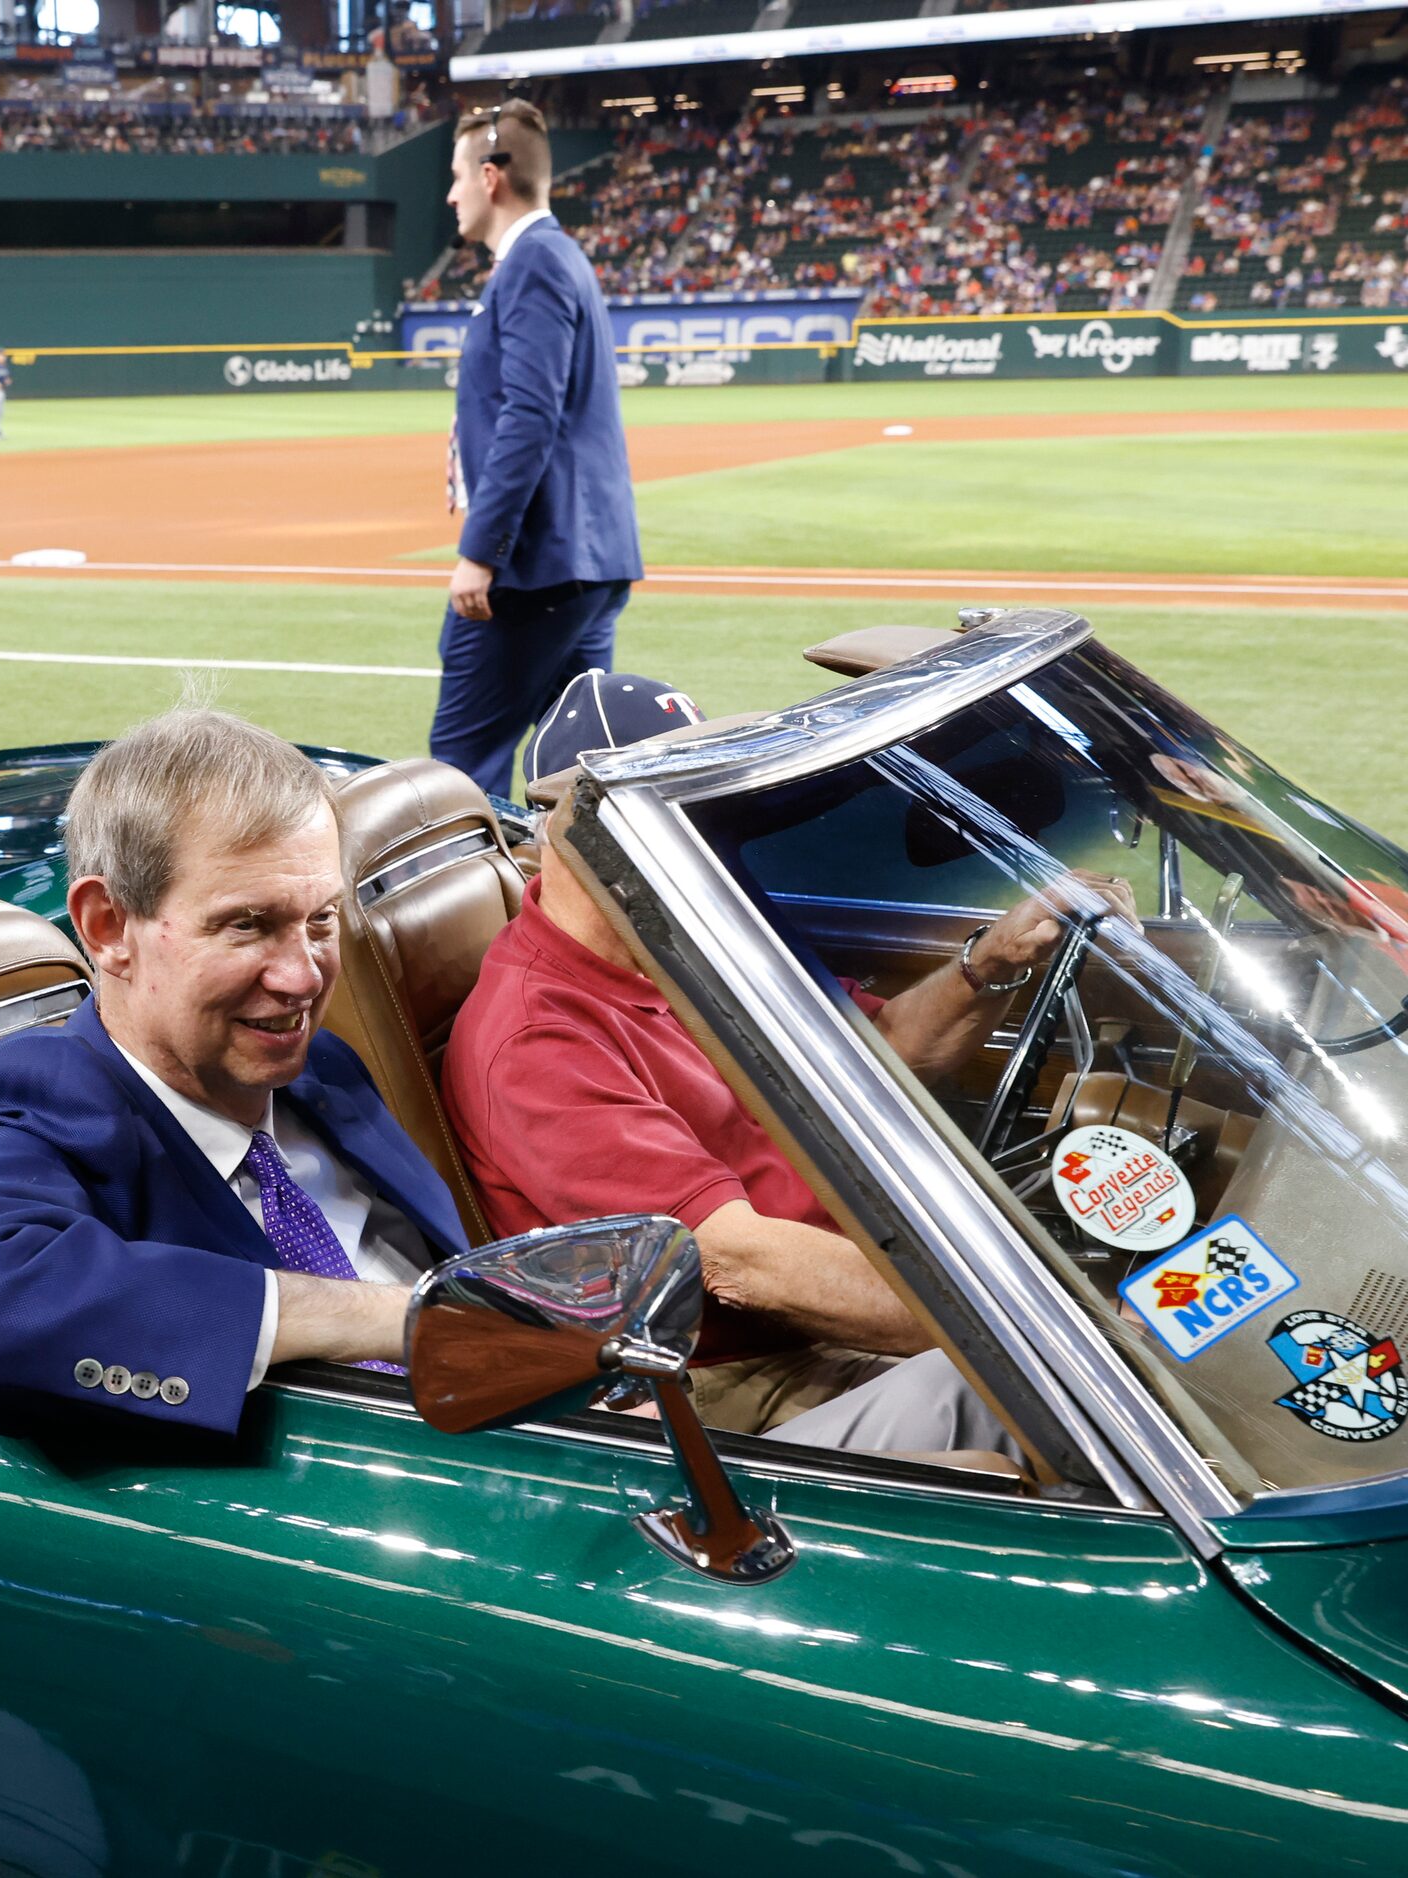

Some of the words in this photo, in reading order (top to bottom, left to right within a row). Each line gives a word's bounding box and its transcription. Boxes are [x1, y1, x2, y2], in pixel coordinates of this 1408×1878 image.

[627, 315, 849, 363] GEICO
[1067, 320, 1161, 373] Kroger
[254, 359, 313, 381] Globe
[313, 358, 351, 380] Life
[1068, 1153, 1158, 1215] Corvette
[1100, 1168, 1175, 1231] Legends
[1172, 1263, 1270, 1338] NCRS
[1284, 1311, 1322, 1327] LONE
[1324, 1313, 1368, 1337] STAR
[1310, 1419, 1399, 1440] CORVETTE
